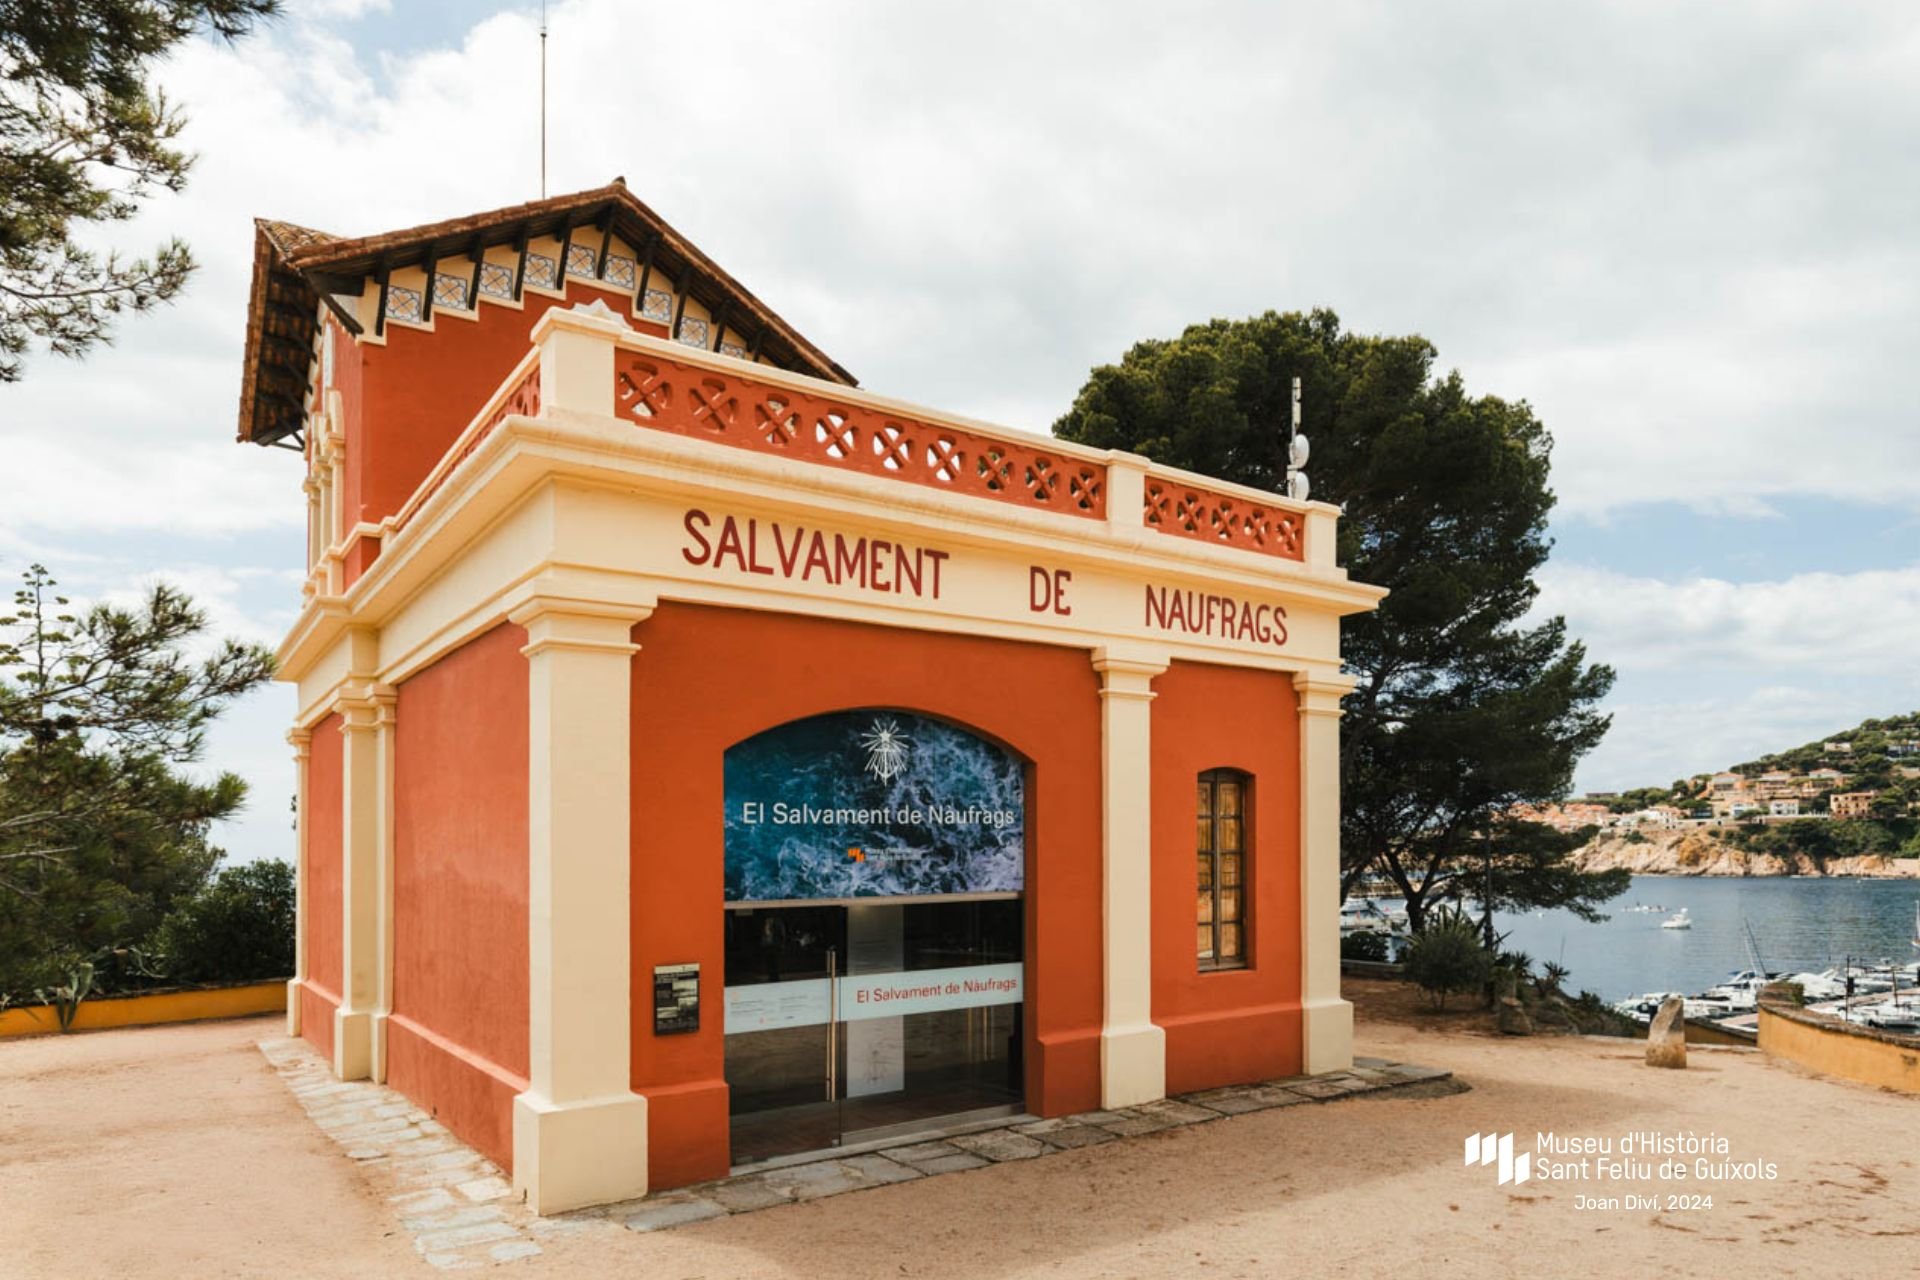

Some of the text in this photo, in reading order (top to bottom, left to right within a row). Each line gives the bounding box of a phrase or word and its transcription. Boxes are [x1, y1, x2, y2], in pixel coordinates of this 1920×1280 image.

[682, 509, 1288, 645] SALVAMENT DE NAUFRAGS
[743, 803, 764, 824] El
[773, 803, 890, 825] Salvament
[897, 803, 921, 824] de
[857, 990, 869, 1003] El
[873, 985, 942, 1002] Salvament
[945, 982, 960, 994] de
